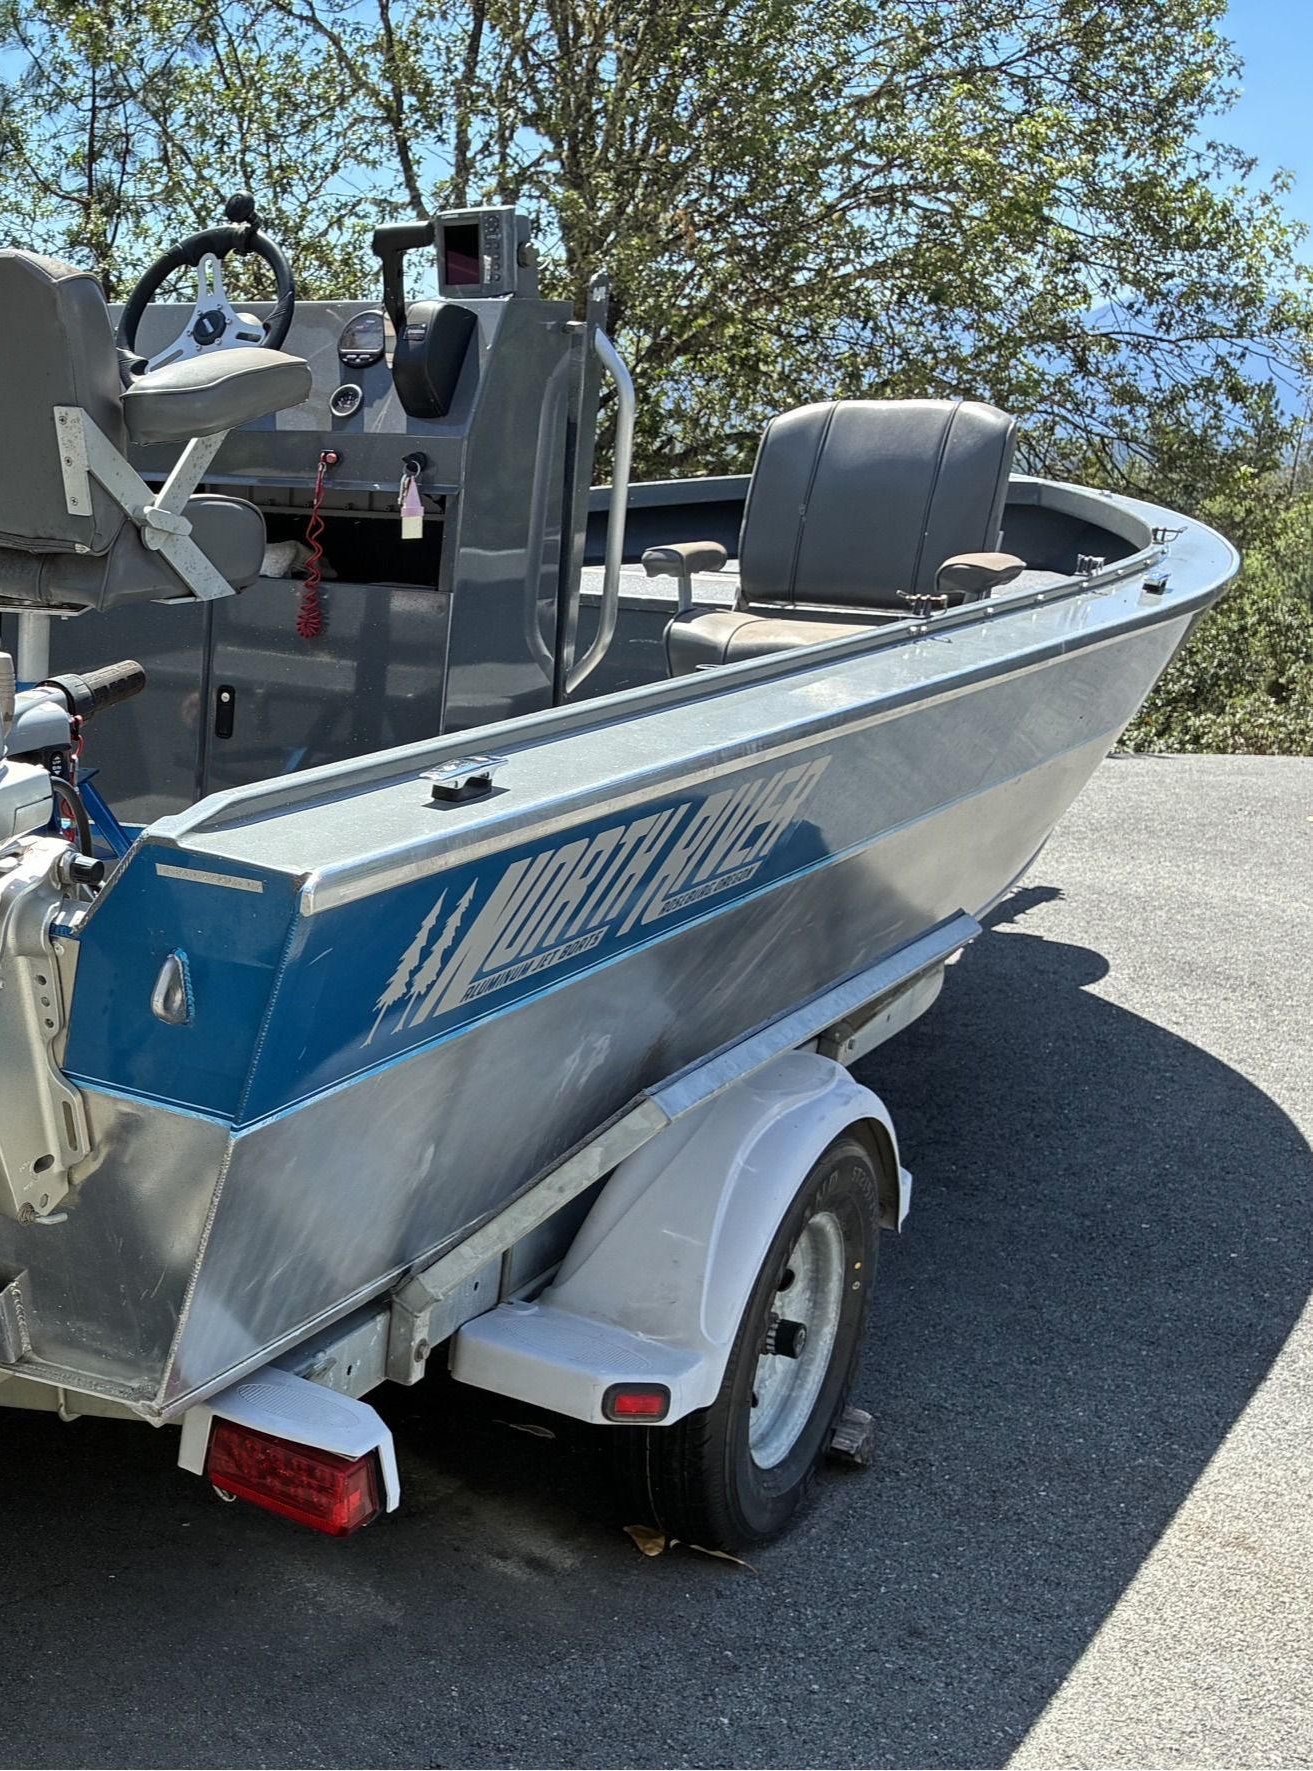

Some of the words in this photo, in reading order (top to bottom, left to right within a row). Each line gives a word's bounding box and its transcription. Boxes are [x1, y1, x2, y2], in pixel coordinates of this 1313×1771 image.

[408, 802, 693, 1028] NORTH
[641, 754, 833, 926] RIVER
[460, 959, 535, 1003] ALUMINUM
[531, 949, 561, 972] JET
[558, 930, 604, 961] BOATS
